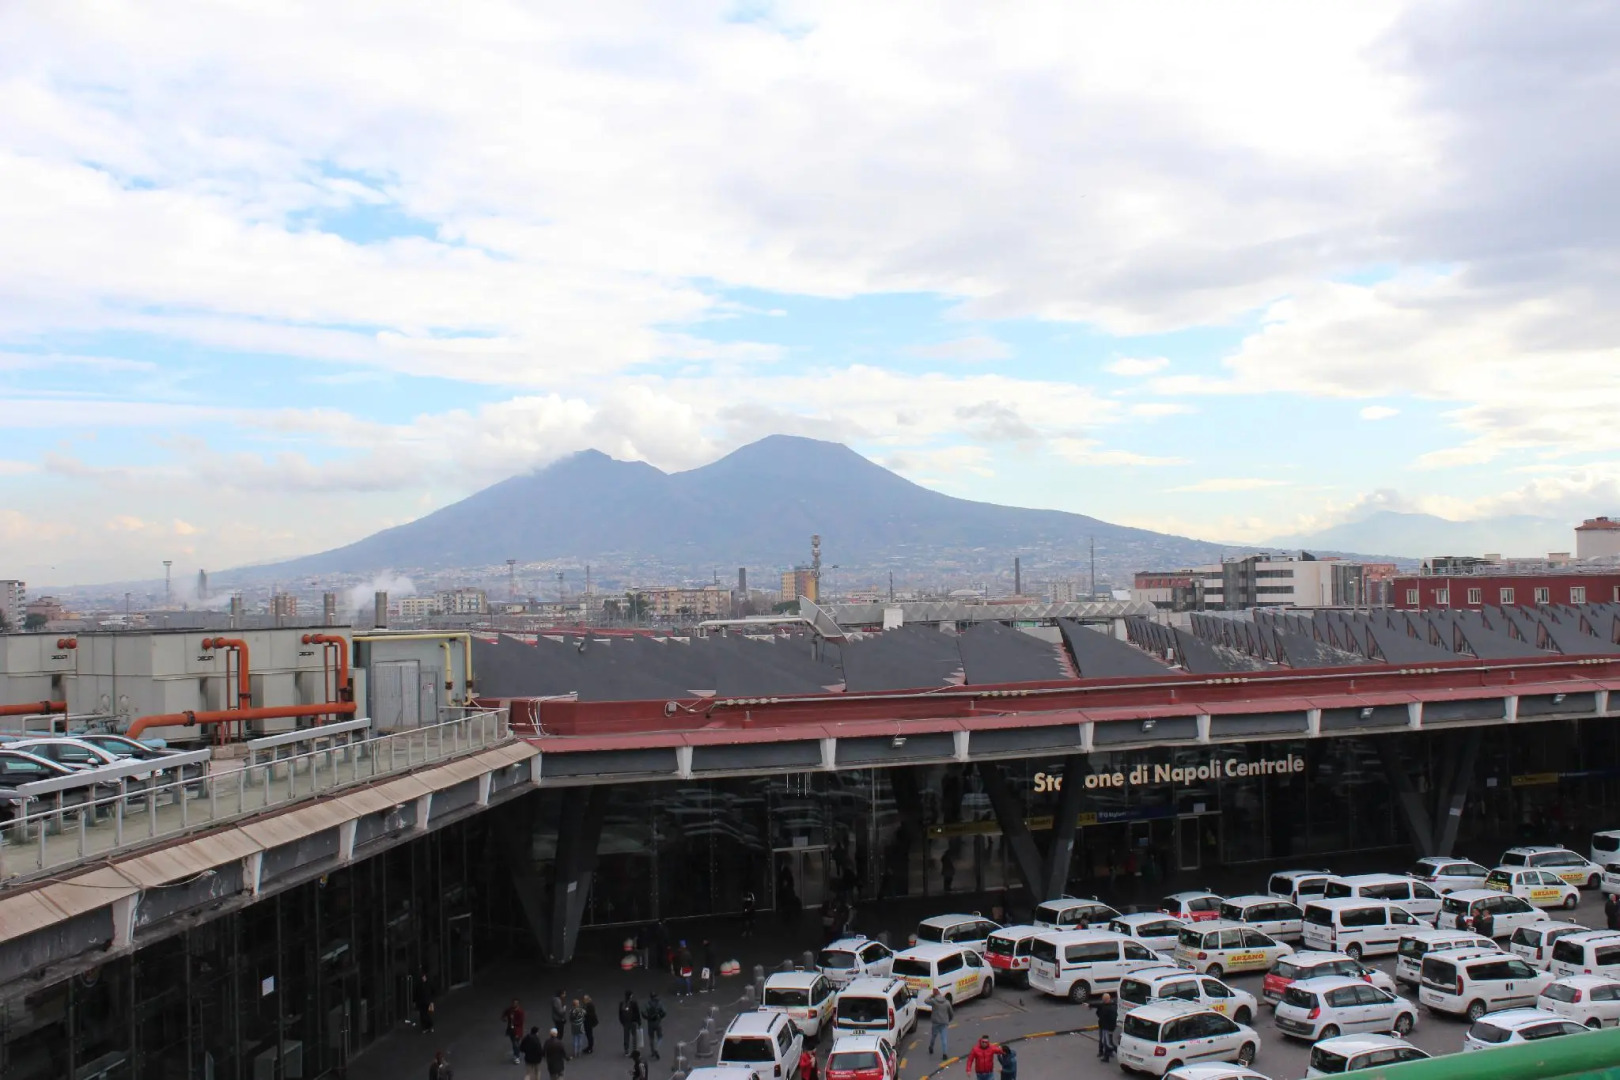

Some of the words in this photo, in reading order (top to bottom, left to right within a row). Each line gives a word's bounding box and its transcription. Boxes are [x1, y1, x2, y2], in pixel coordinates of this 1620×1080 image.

[1129, 764, 1148, 785] di
[1154, 759, 1221, 786] Napoli
[1225, 753, 1304, 777] Centrale
